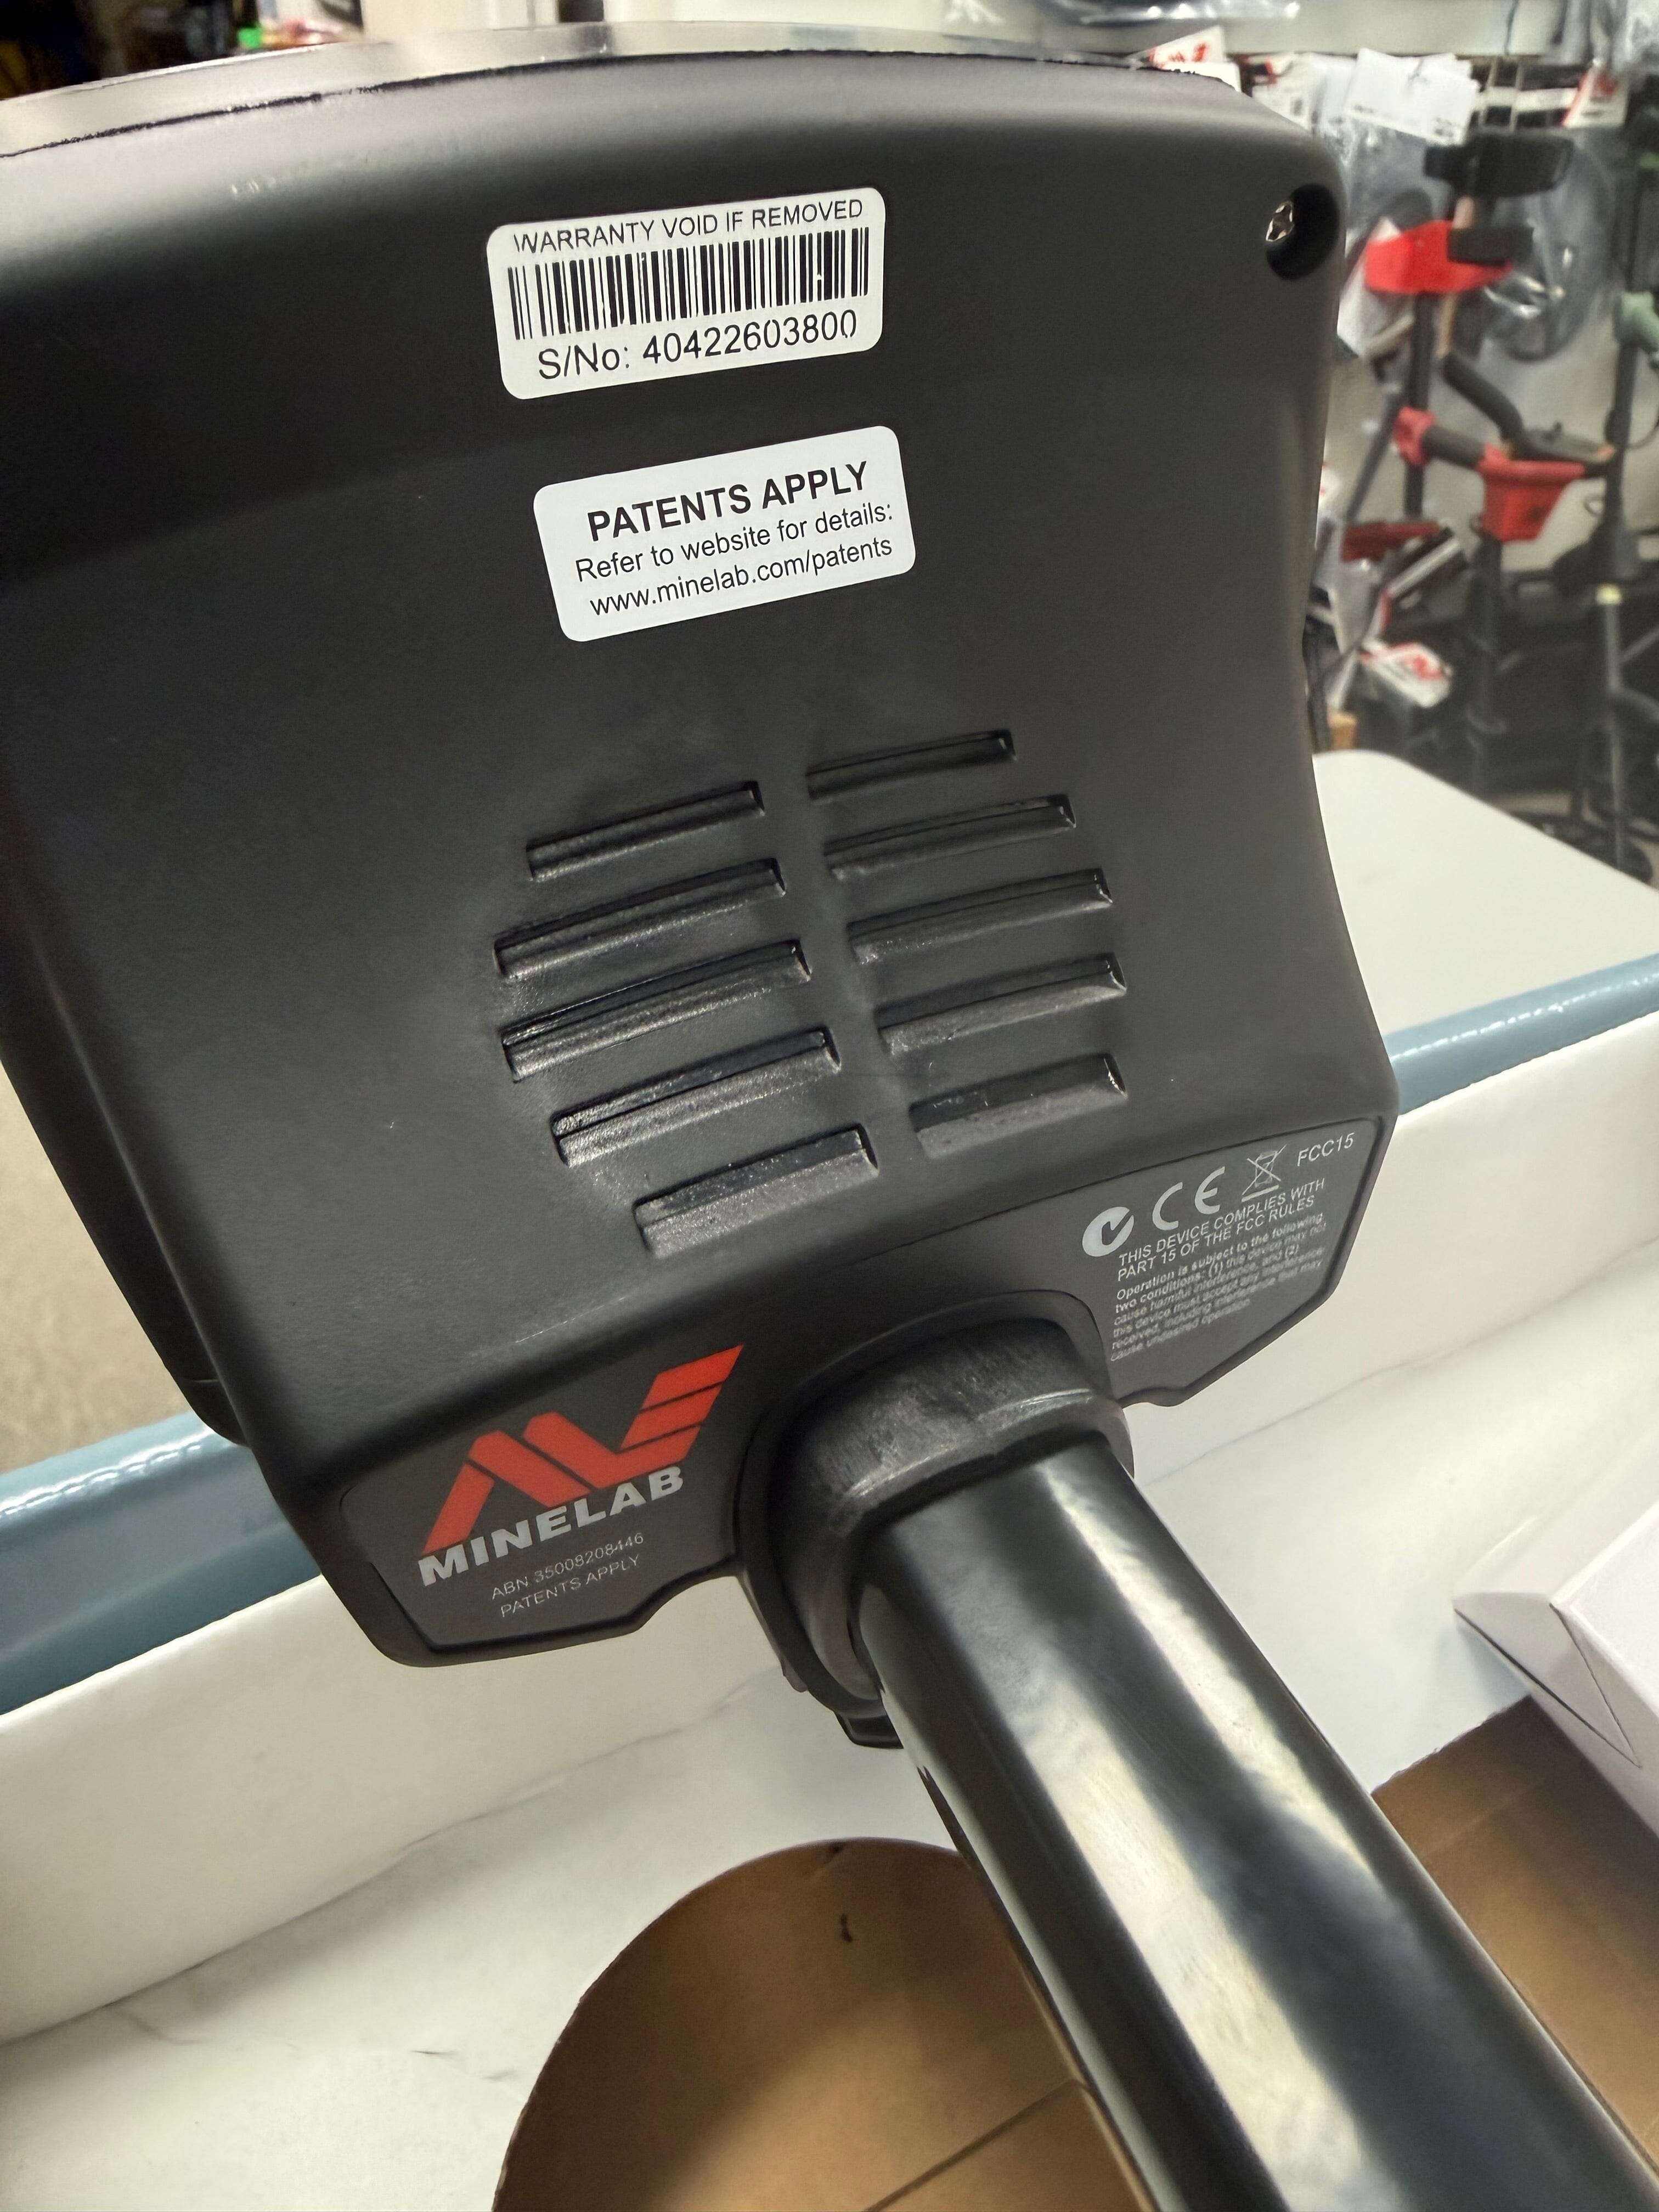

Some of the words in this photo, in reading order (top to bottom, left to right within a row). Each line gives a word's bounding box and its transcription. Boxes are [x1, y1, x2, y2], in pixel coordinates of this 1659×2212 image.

[514, 221, 654, 253] WARRANTY
[662, 215, 718, 239] VOID
[727, 211, 743, 232] IF
[752, 199, 863, 229] REMOVED
[538, 343, 630, 380] S/No:
[642, 309, 857, 364] 40422603800
[587, 484, 752, 542] PATENTS
[762, 461, 867, 509] APPLY
[575, 551, 644, 582] Refer
[650, 545, 674, 567] to
[680, 527, 771, 561] website
[776, 517, 807, 542] for
[815, 503, 894, 534] details:
[590, 538, 893, 616] www.minelab.com/patents
[1297, 1132, 1355, 1167] FCC15
[1117, 1271, 1174, 1300] Operation
[1192, 1246, 1233, 1271] subject
[1238, 1242, 1248, 1251] to
[1251, 1233, 1269, 1246] the
[1273, 1212, 1323, 1237] following
[1118, 1256, 1156, 1282] PART
[1161, 1248, 1176, 1264] 15
[1180, 1238, 1200, 1257] OF
[1205, 1226, 1232, 1247] THE
[1237, 1215, 1265, 1235] FCC
[1268, 1195, 1315, 1222] RULES
[1119, 1244, 1152, 1266] THIS
[1156, 1221, 1210, 1253] DEVICE
[1214, 1192, 1286, 1230] COMPLIES
[1291, 1177, 1325, 1200] WITH
[1115, 1298, 1137, 1313] two
[417, 1465, 684, 1587] MINELAB
[492, 1576, 528, 1600] ABN
[500, 1577, 582, 1618] PATENTS
[585, 1554, 639, 1585] APPLY
